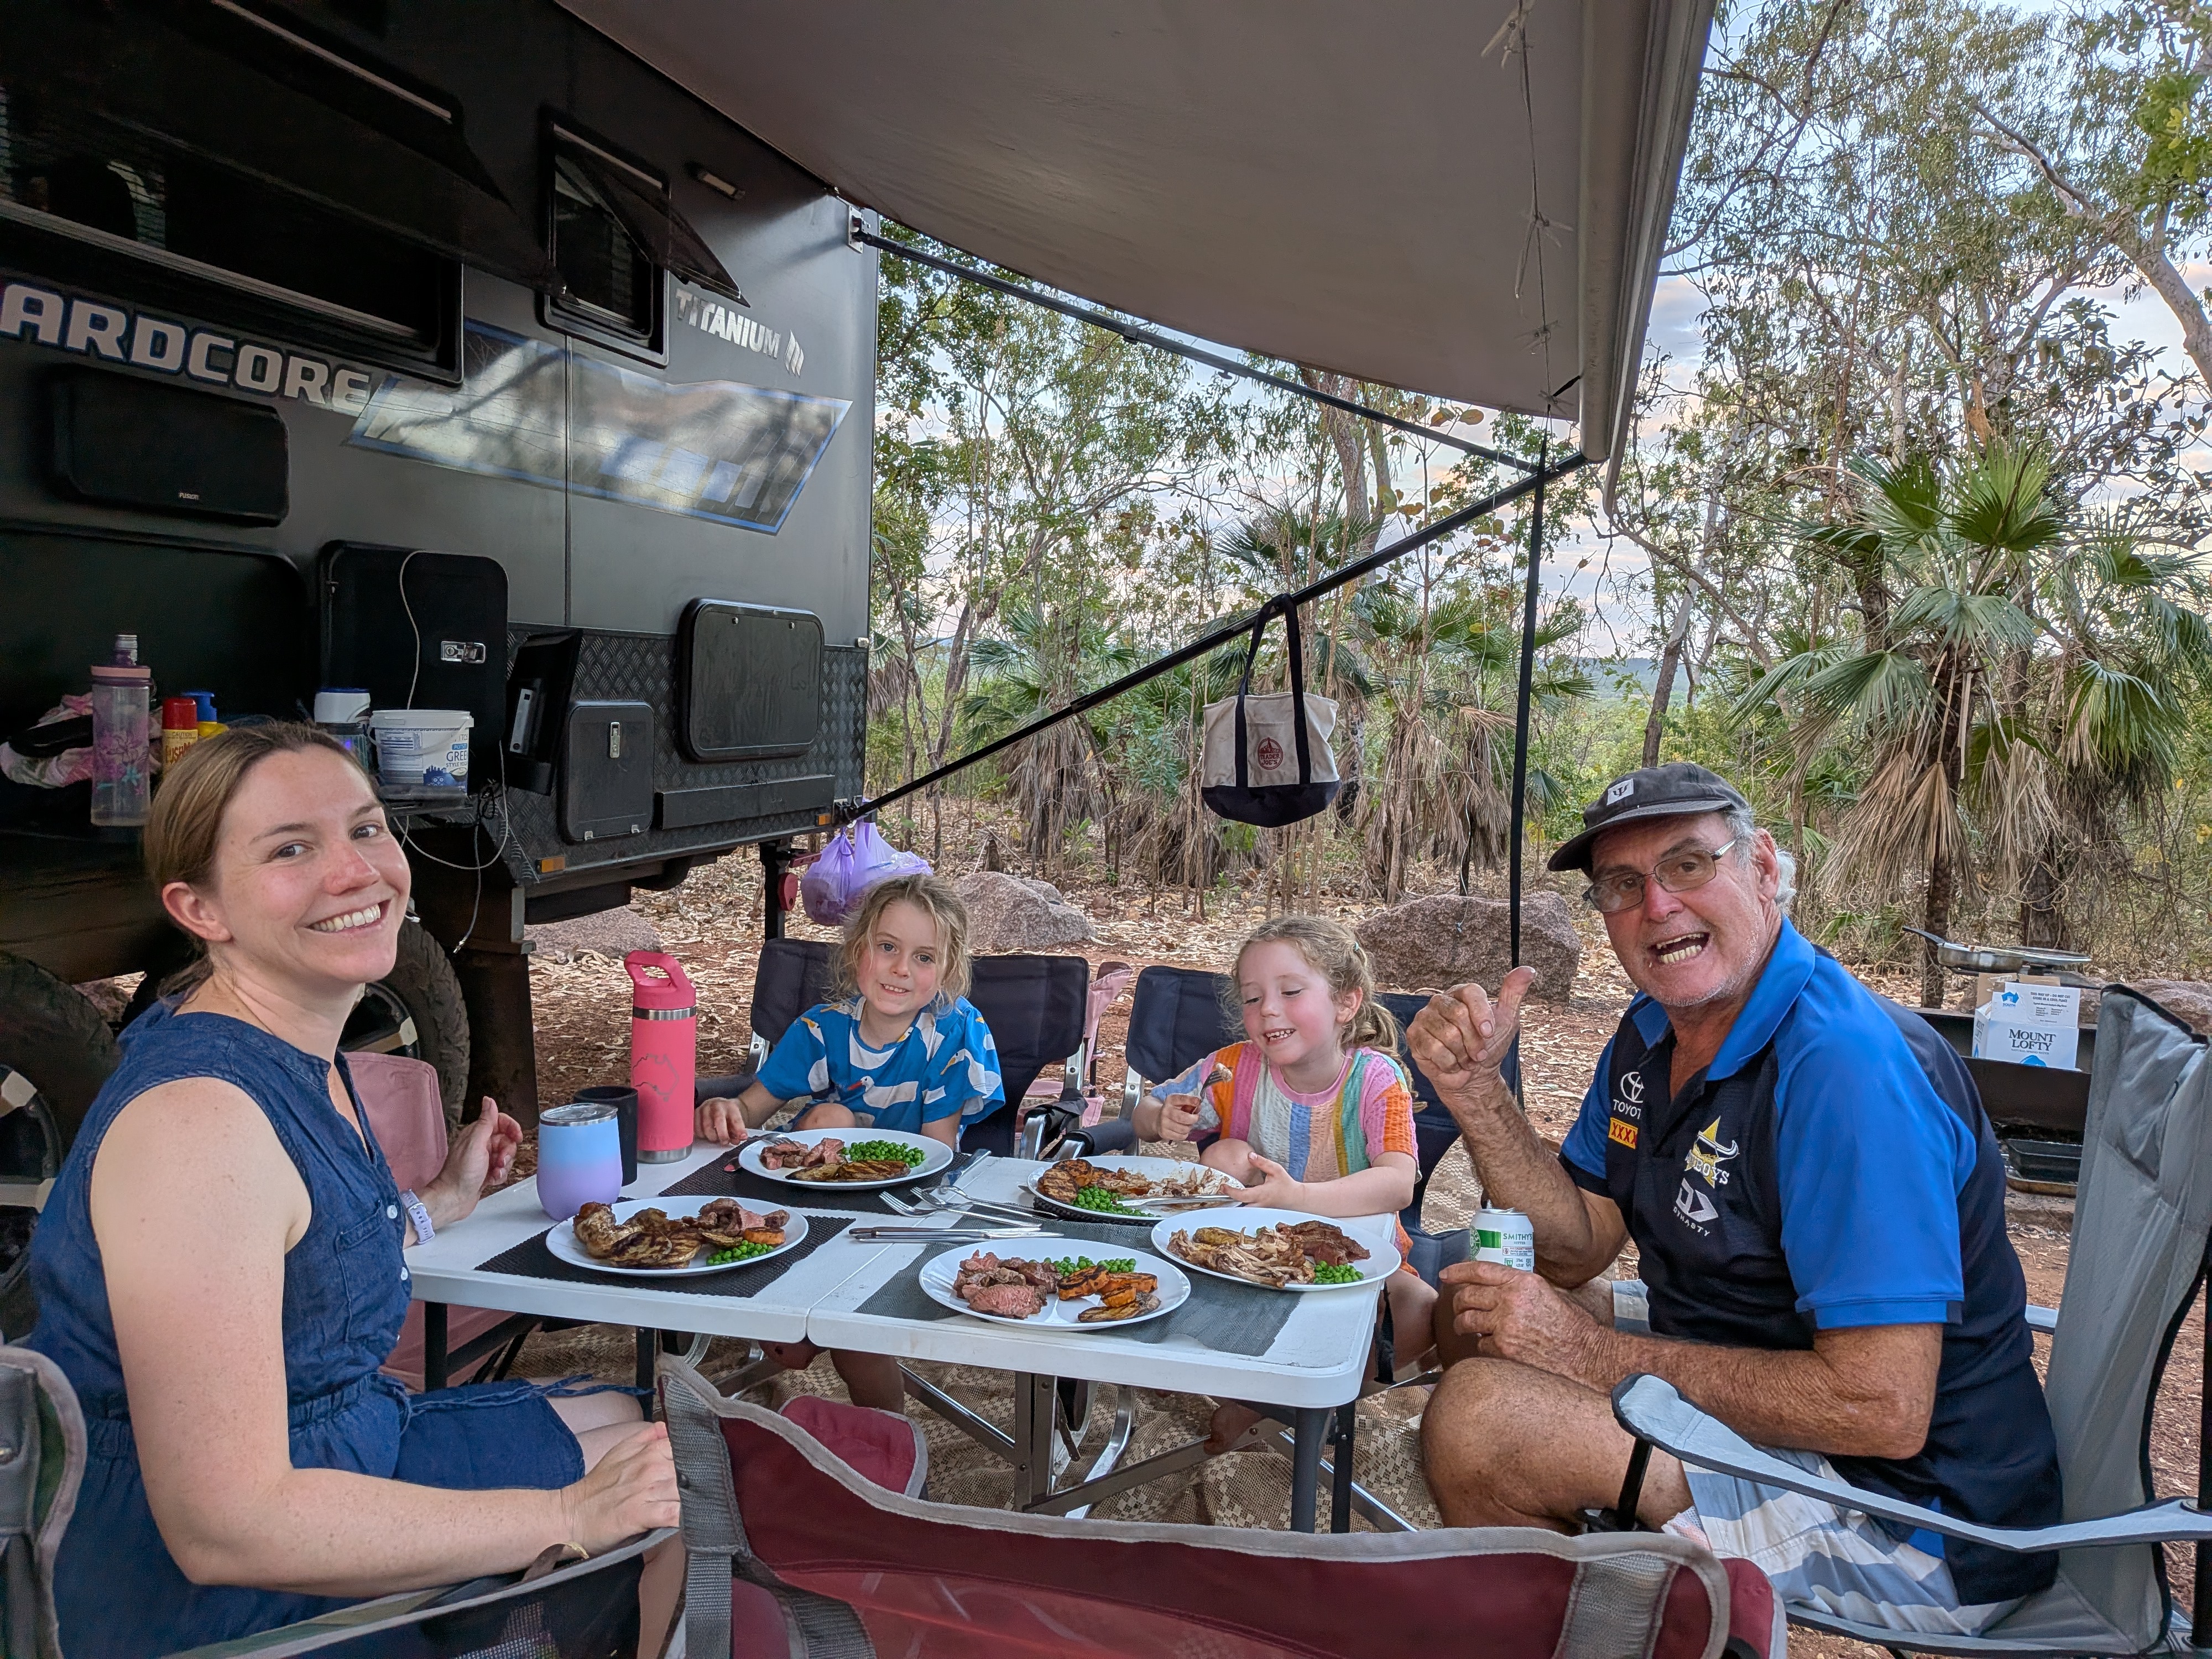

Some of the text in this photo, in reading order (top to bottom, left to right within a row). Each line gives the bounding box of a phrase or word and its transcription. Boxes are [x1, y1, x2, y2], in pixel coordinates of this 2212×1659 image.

[675, 288, 781, 360] TITANIUM
[0, 283, 370, 415] ARDCORE
[446, 750, 468, 762] GREE
[2008, 1029, 2056, 1042] MOUNT
[2012, 1039, 2052, 1051] LOFTY
[1613, 1099, 1641, 1120] TOYOT
[1684, 1149, 1730, 1185] BOYS
[1673, 1206, 1710, 1237] DYNASTY
